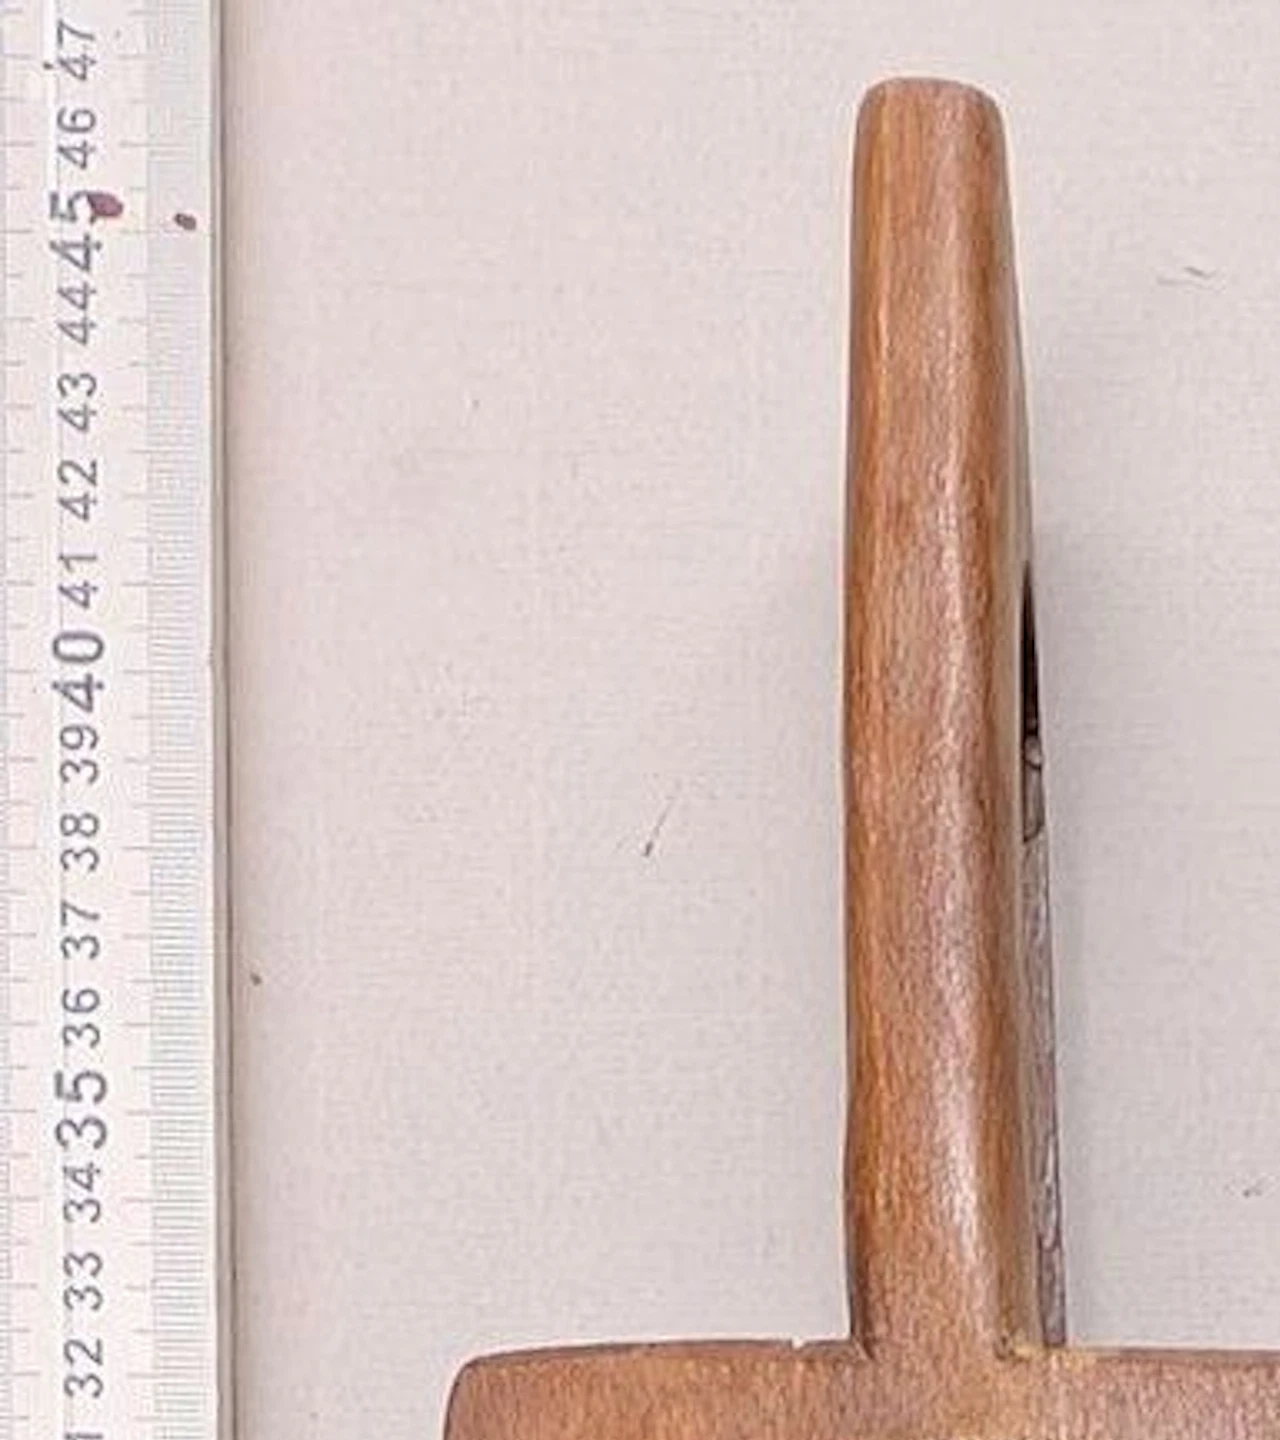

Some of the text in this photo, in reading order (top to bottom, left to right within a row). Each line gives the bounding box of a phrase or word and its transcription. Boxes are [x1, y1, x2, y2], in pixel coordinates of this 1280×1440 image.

[56, 19, 96, 82] 47
[56, 108, 96, 170] 46
[50, 190, 103, 273] 45
[57, 282, 97, 346] 44
[57, 373, 97, 433] 43
[57, 460, 97, 522] 42
[58, 552, 98, 610] 41
[51, 631, 105, 713] 40
[59, 725, 99, 785] 39
[60, 812, 100, 872] 38
[60, 899, 100, 960] 37
[61, 988, 100, 1049] 36
[54, 1070, 108, 1152] 35
[62, 1162, 101, 1223] 34
[63, 1252, 103, 1311] 33
[63, 1339, 104, 1398] 32
